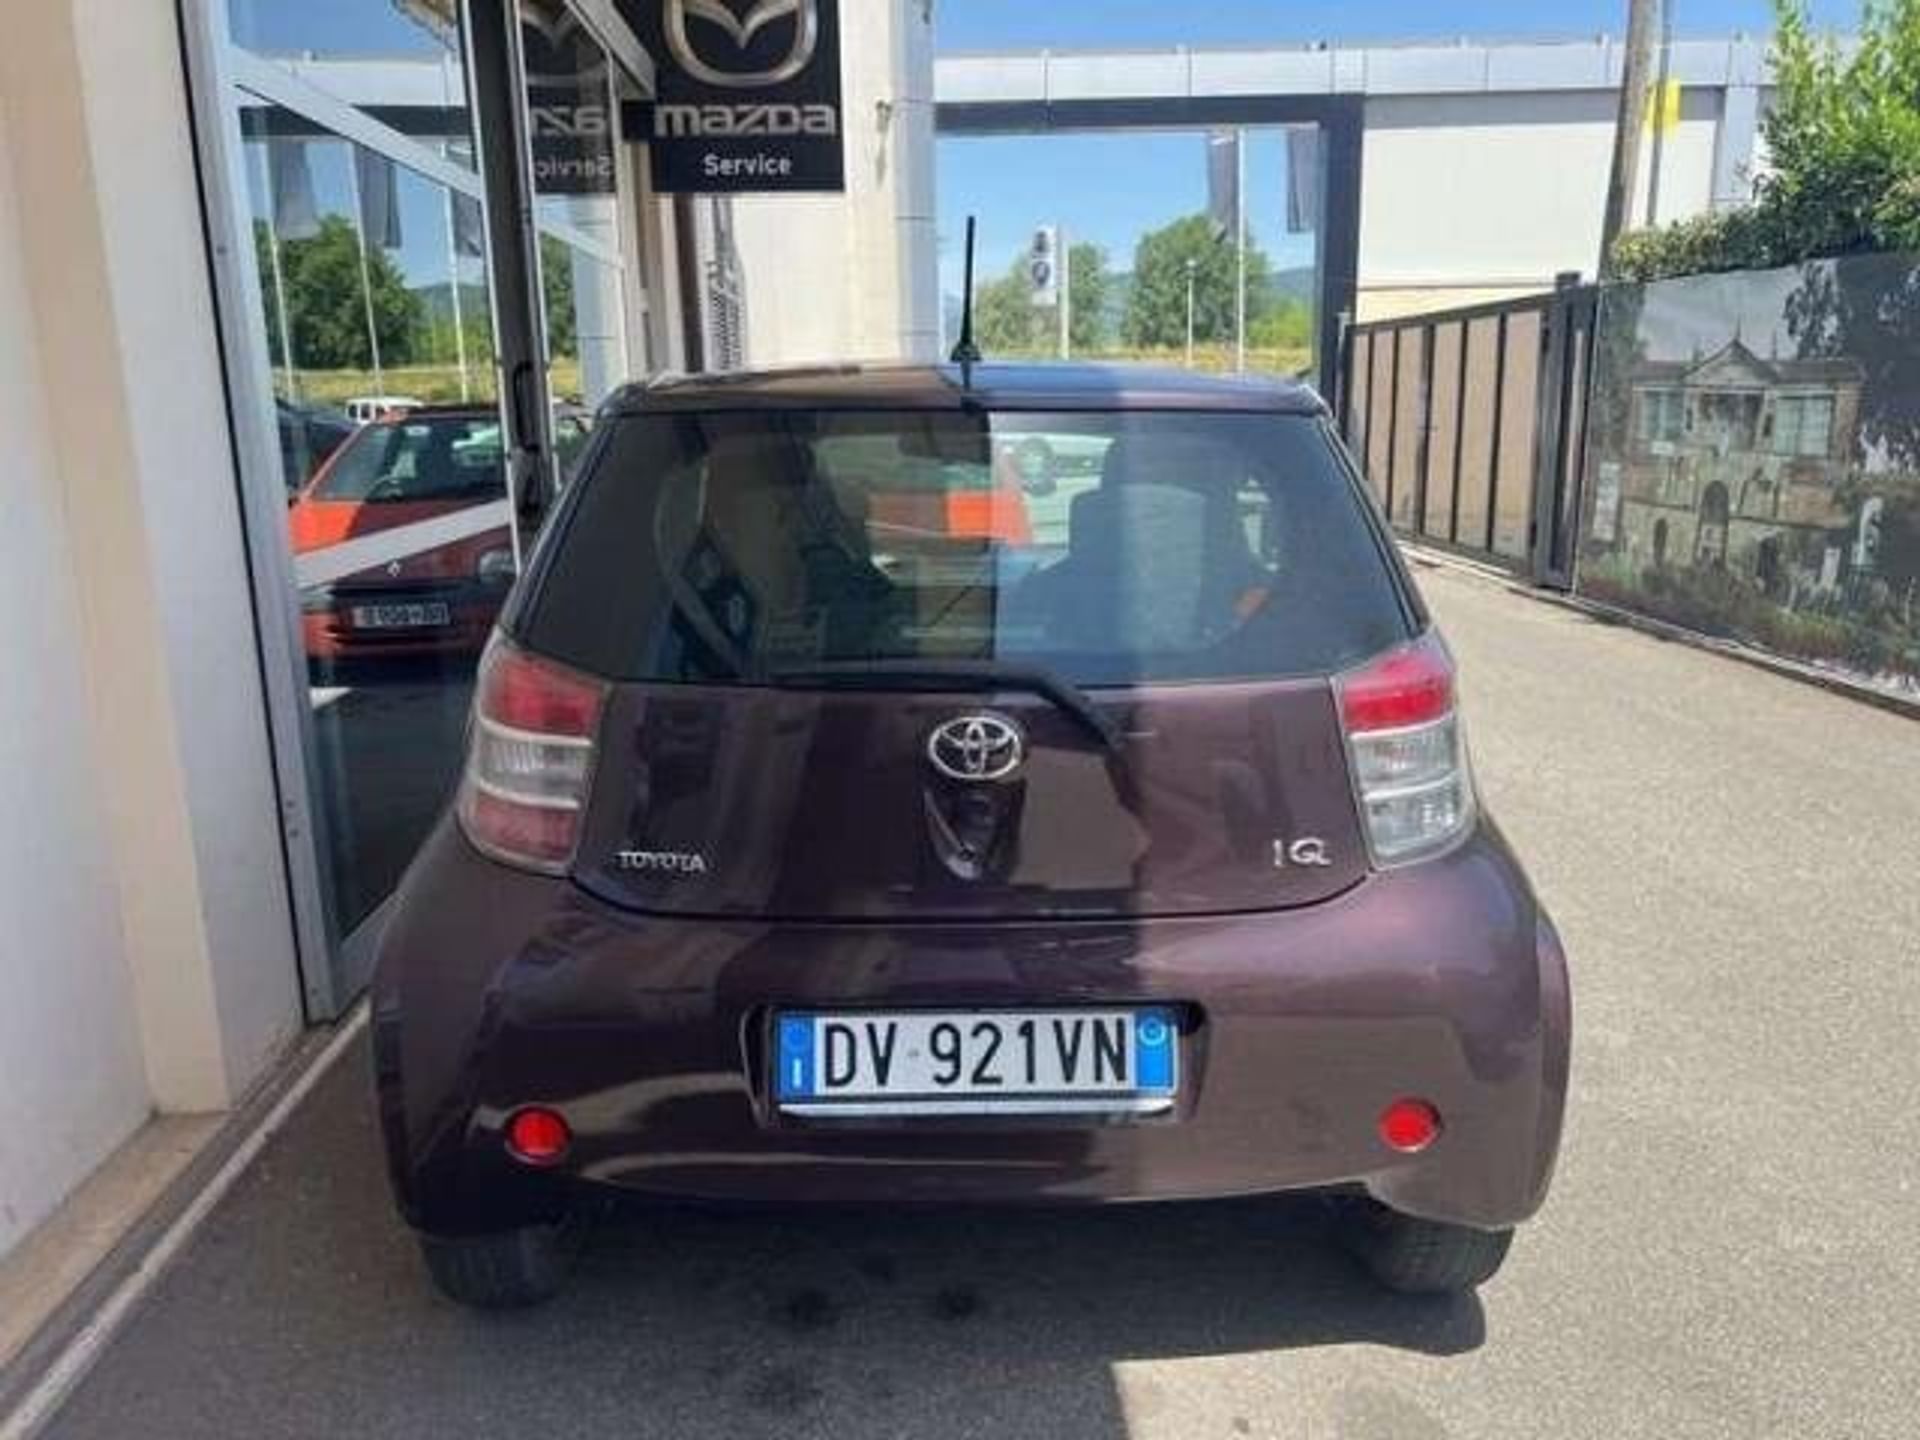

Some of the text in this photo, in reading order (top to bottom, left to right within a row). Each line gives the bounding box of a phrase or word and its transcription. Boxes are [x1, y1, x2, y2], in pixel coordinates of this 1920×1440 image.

[703, 153, 793, 176] Service
[618, 850, 706, 872] TOYOTA
[823, 1017, 1128, 1087] DV 921VN
